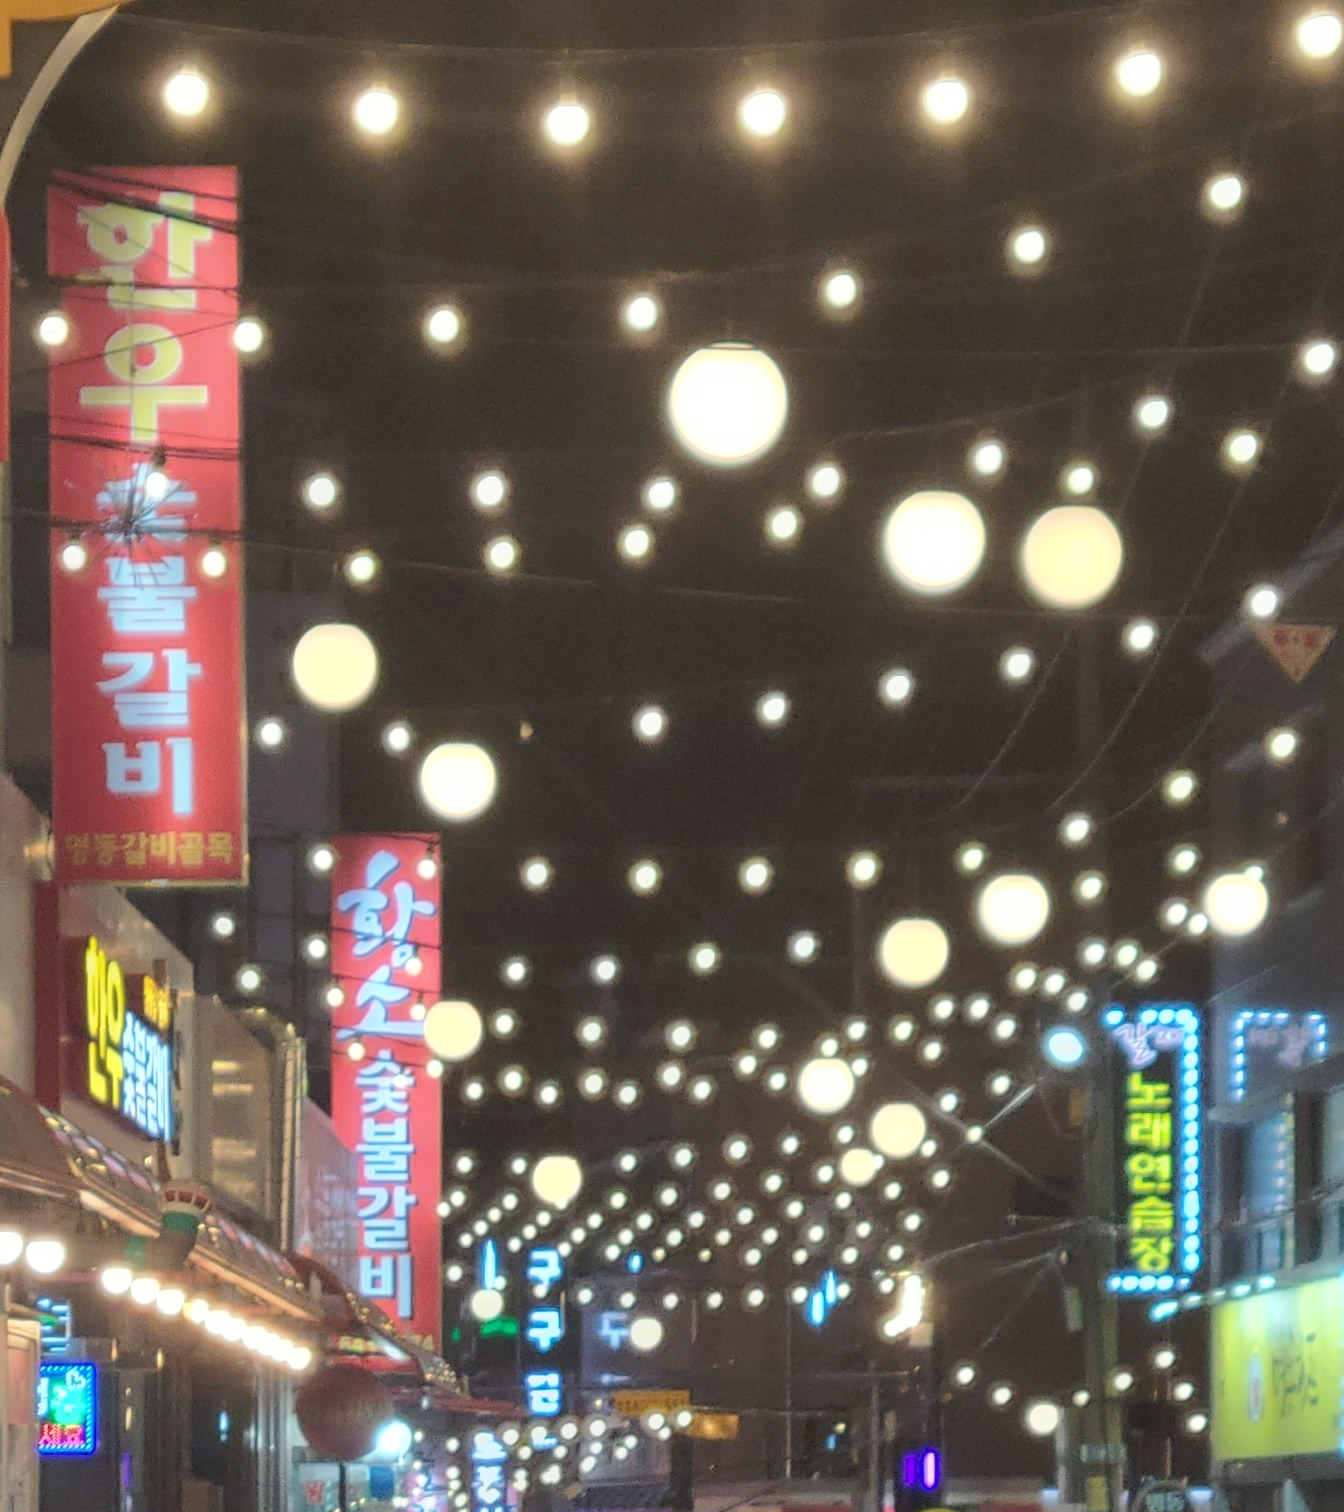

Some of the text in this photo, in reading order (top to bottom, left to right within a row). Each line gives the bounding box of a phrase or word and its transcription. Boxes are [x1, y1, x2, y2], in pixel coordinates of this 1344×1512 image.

[76, 190, 214, 442] 한우
[85, 935, 125, 1109] 한우
[354, 1048, 418, 1320] 숯불갈비
[1126, 1072, 1174, 1273] 노래연습장
